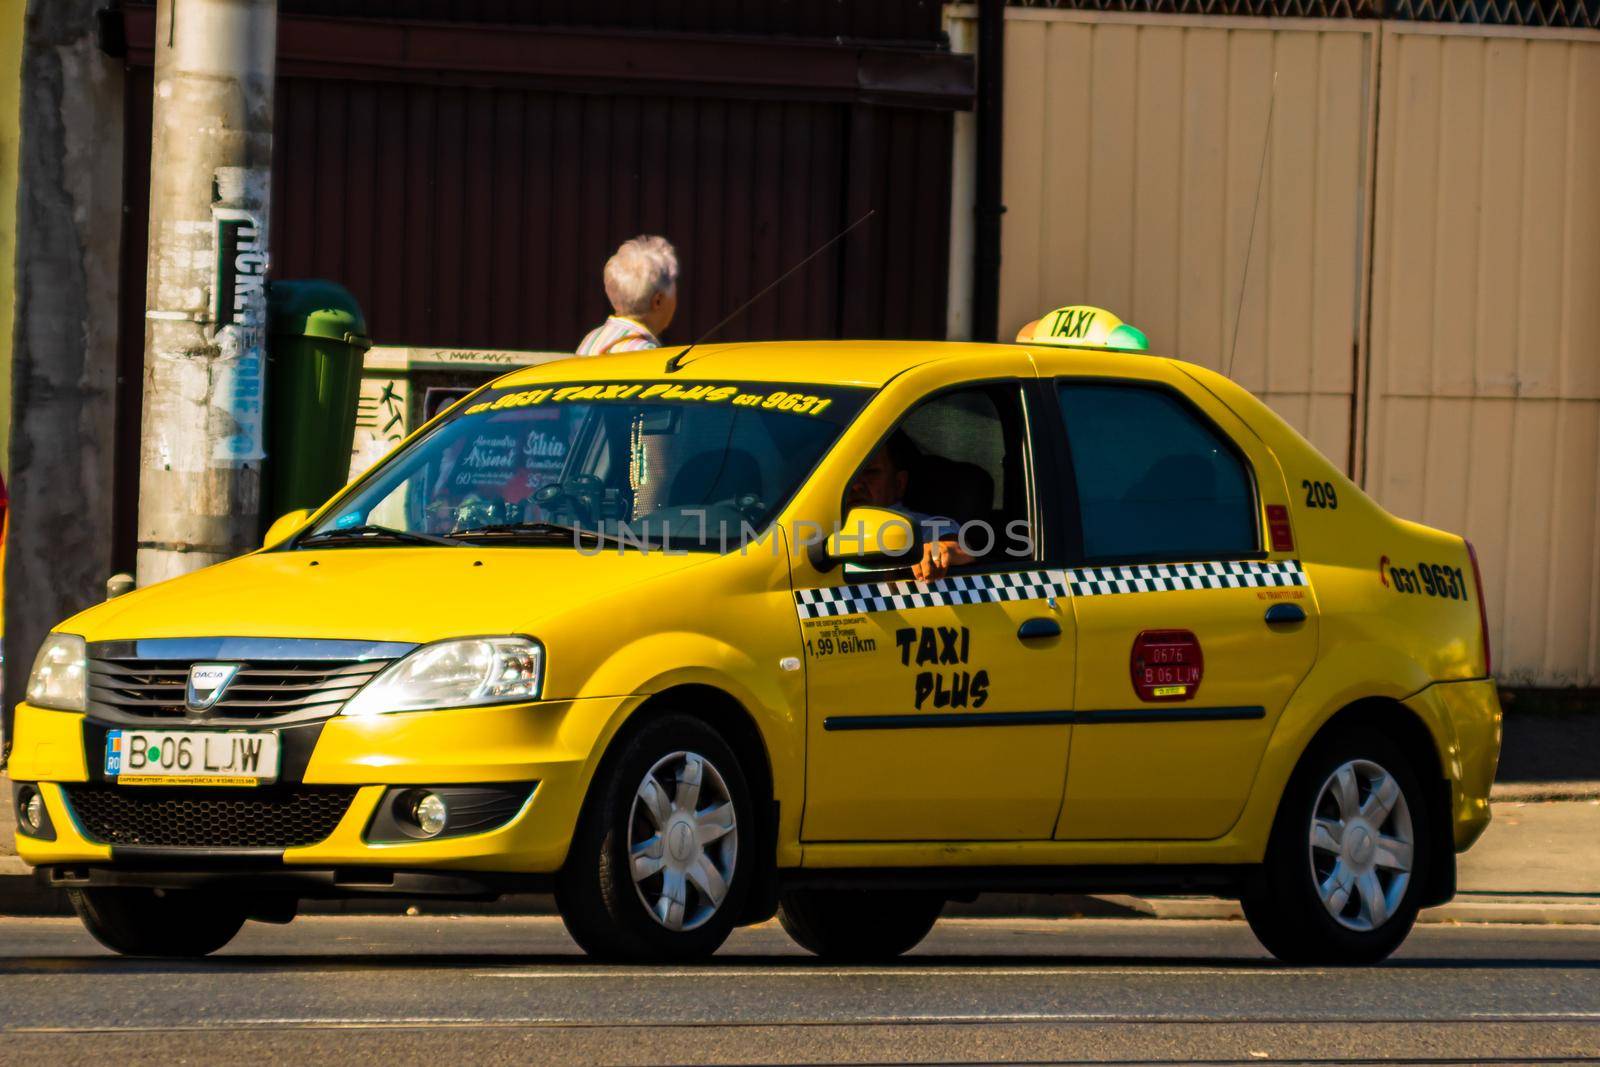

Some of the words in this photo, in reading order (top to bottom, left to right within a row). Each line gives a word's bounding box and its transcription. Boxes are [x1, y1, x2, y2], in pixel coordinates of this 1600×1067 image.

[1051, 310, 1096, 338] TAXI
[551, 384, 644, 402] TAXI
[638, 384, 739, 401] PLUS
[732, 394, 764, 407] 031
[761, 391, 832, 416] 9631
[1302, 479, 1338, 510] 209
[1390, 566, 1422, 595] 031
[1418, 561, 1468, 601] 9631
[806, 638, 834, 659] 1,99
[837, 636, 876, 655] lei/km
[895, 626, 970, 667] TAXI
[193, 671, 224, 679] DACIA
[914, 670, 990, 710] PLUS
[1144, 668, 1153, 683] B
[1158, 667, 1173, 682] 06
[108, 756, 120, 770] RO
[129, 735, 148, 769] B
[160, 736, 193, 770] 06
[203, 737, 263, 773] LJW
